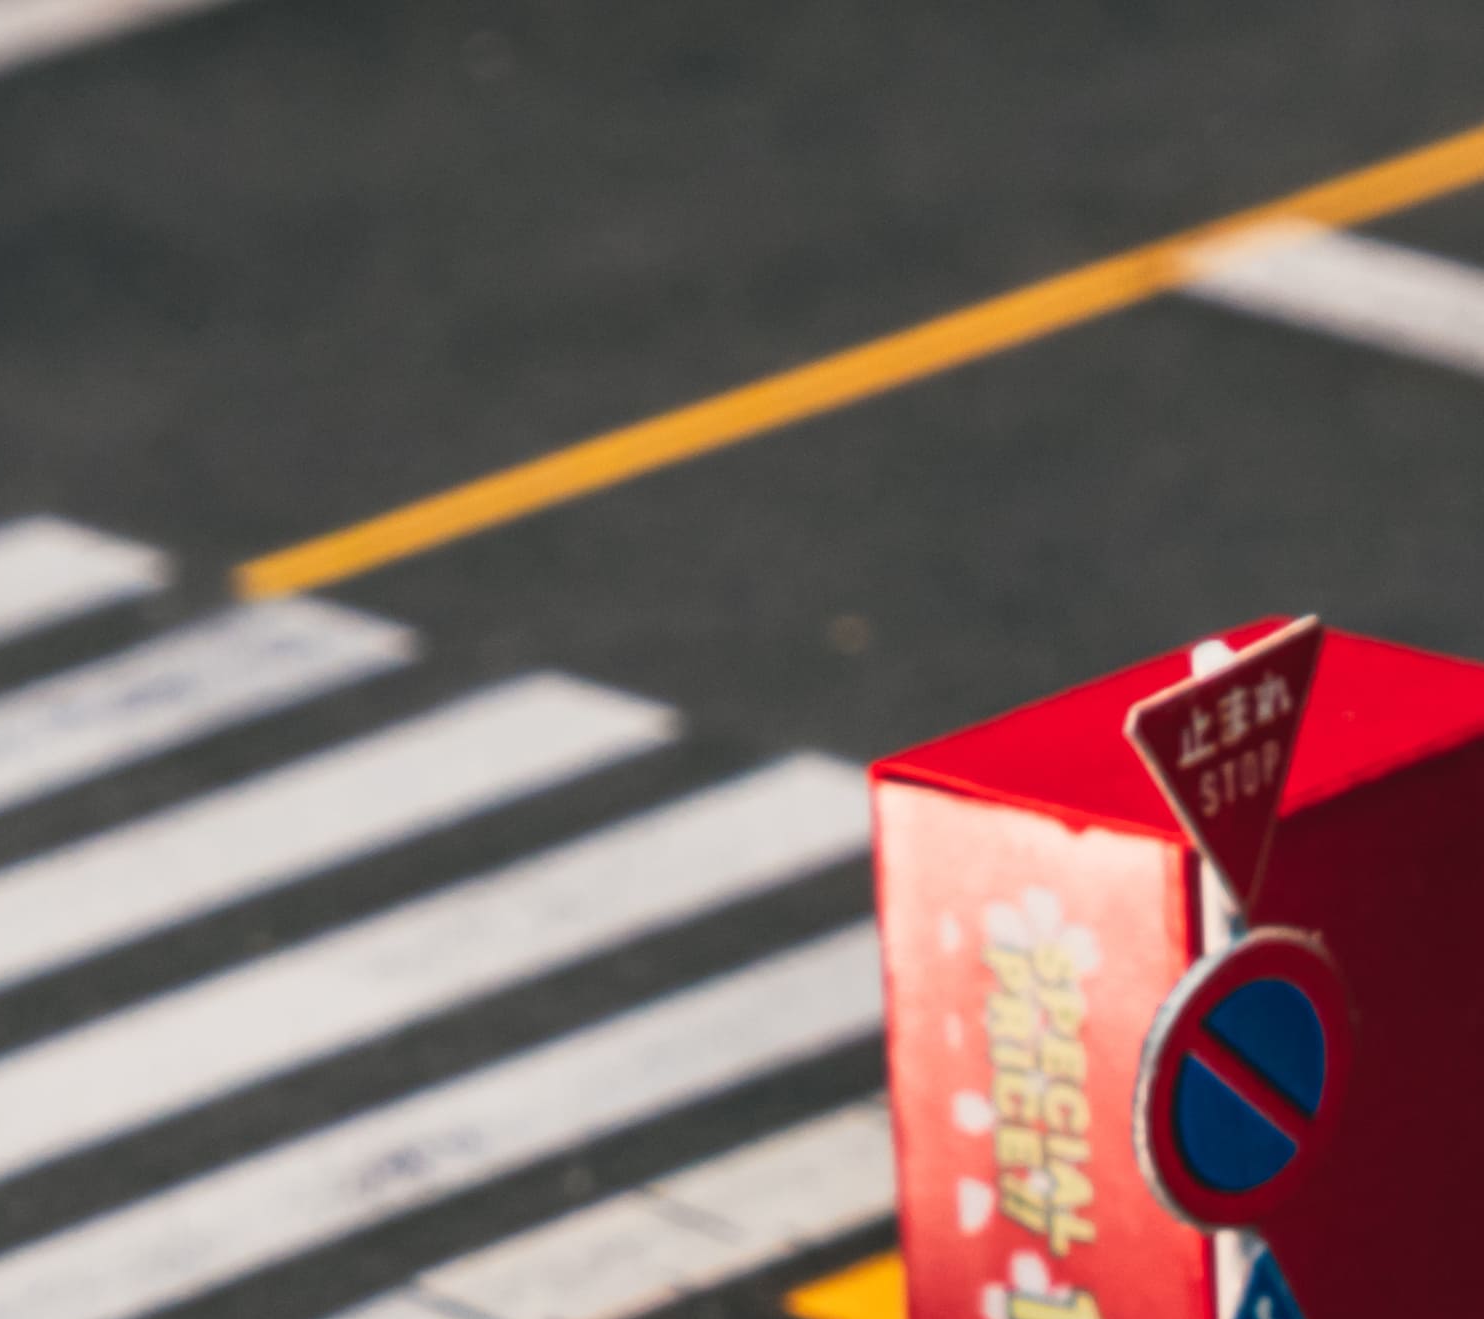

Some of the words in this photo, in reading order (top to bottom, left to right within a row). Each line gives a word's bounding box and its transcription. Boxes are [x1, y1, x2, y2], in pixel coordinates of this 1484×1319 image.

[1176, 669, 1295, 769] 止まれ
[1199, 739, 1281, 818] STOP
[1029, 940, 1098, 1258] SPECIAL
